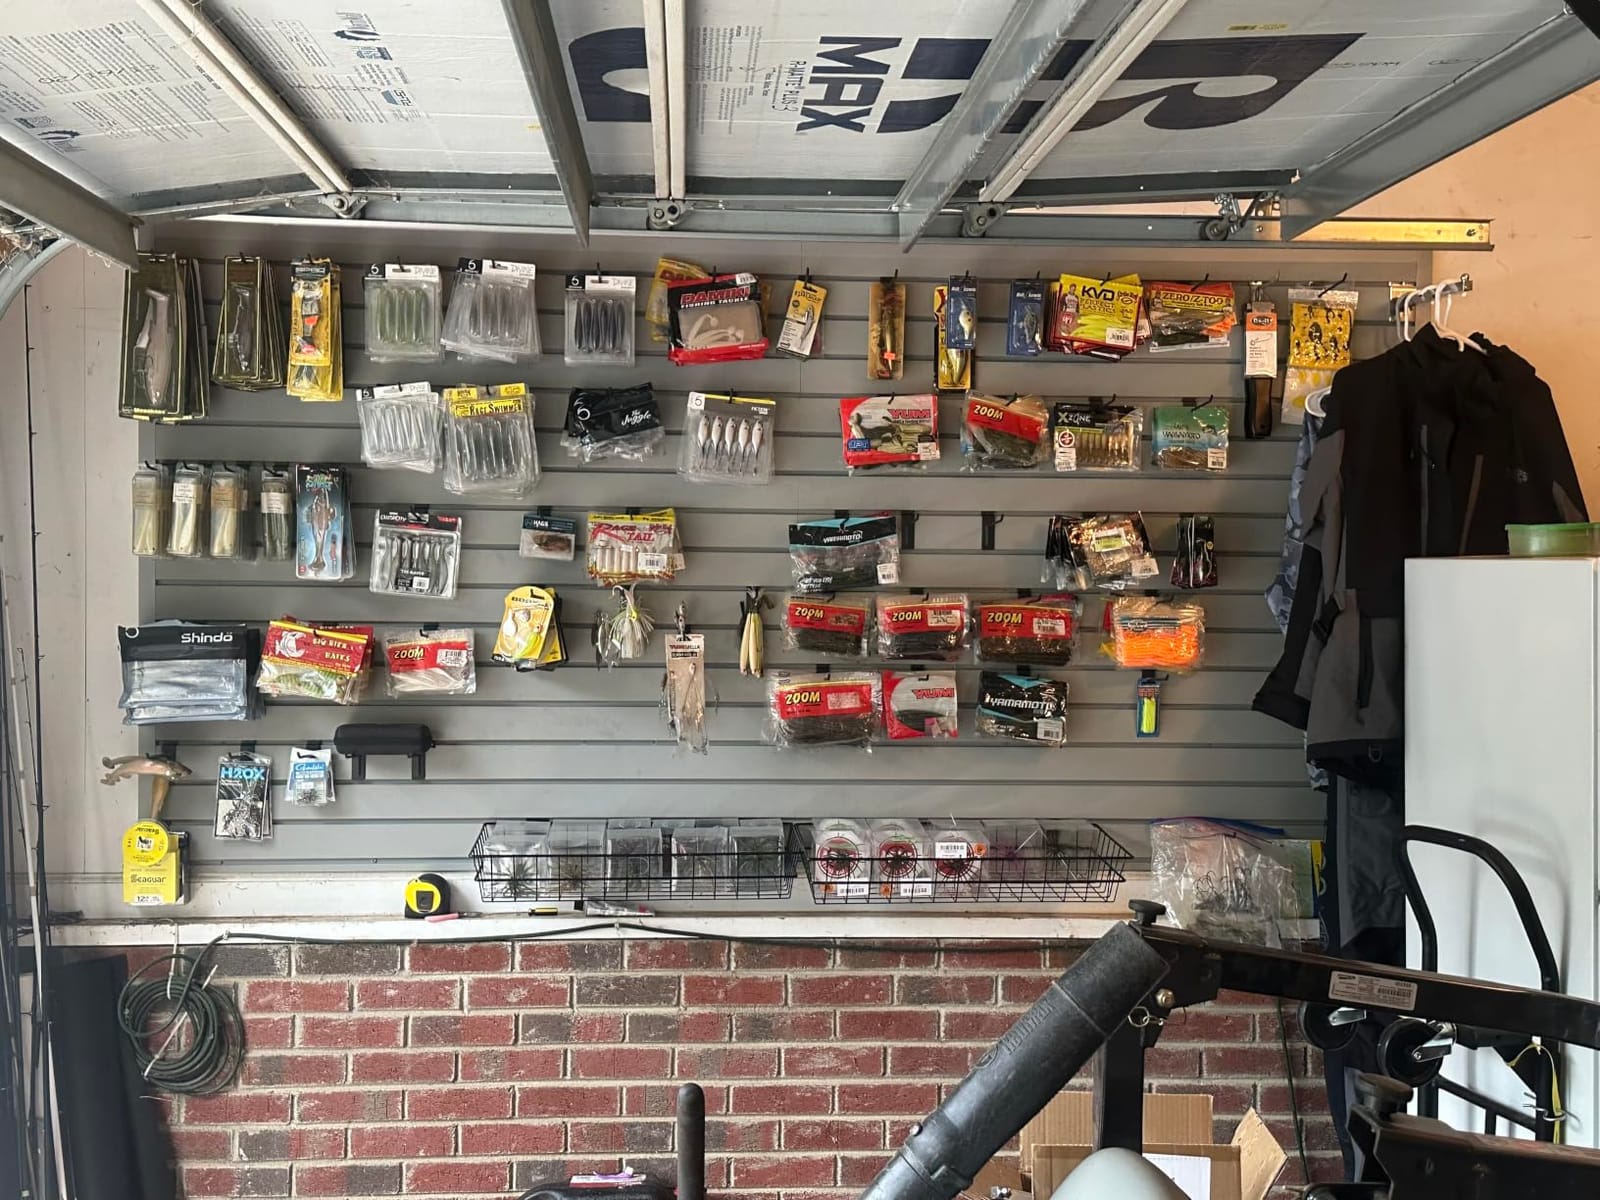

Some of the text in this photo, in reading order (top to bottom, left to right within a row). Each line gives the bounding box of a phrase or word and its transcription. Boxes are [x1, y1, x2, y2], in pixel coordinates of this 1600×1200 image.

[796, 36, 902, 133] MAX
[371, 264, 379, 275] 6
[468, 260, 476, 270] 6
[571, 275, 579, 286] 6
[1081, 285, 1115, 301] KVD
[887, 408, 931, 419] YUM
[973, 404, 1004, 420] ZOOM
[795, 607, 824, 618] ZOOM
[892, 611, 921, 622] ZOOM
[987, 612, 1022, 624] ZOOM
[394, 645, 424, 659] ZOOM
[785, 690, 821, 705] ZOOM
